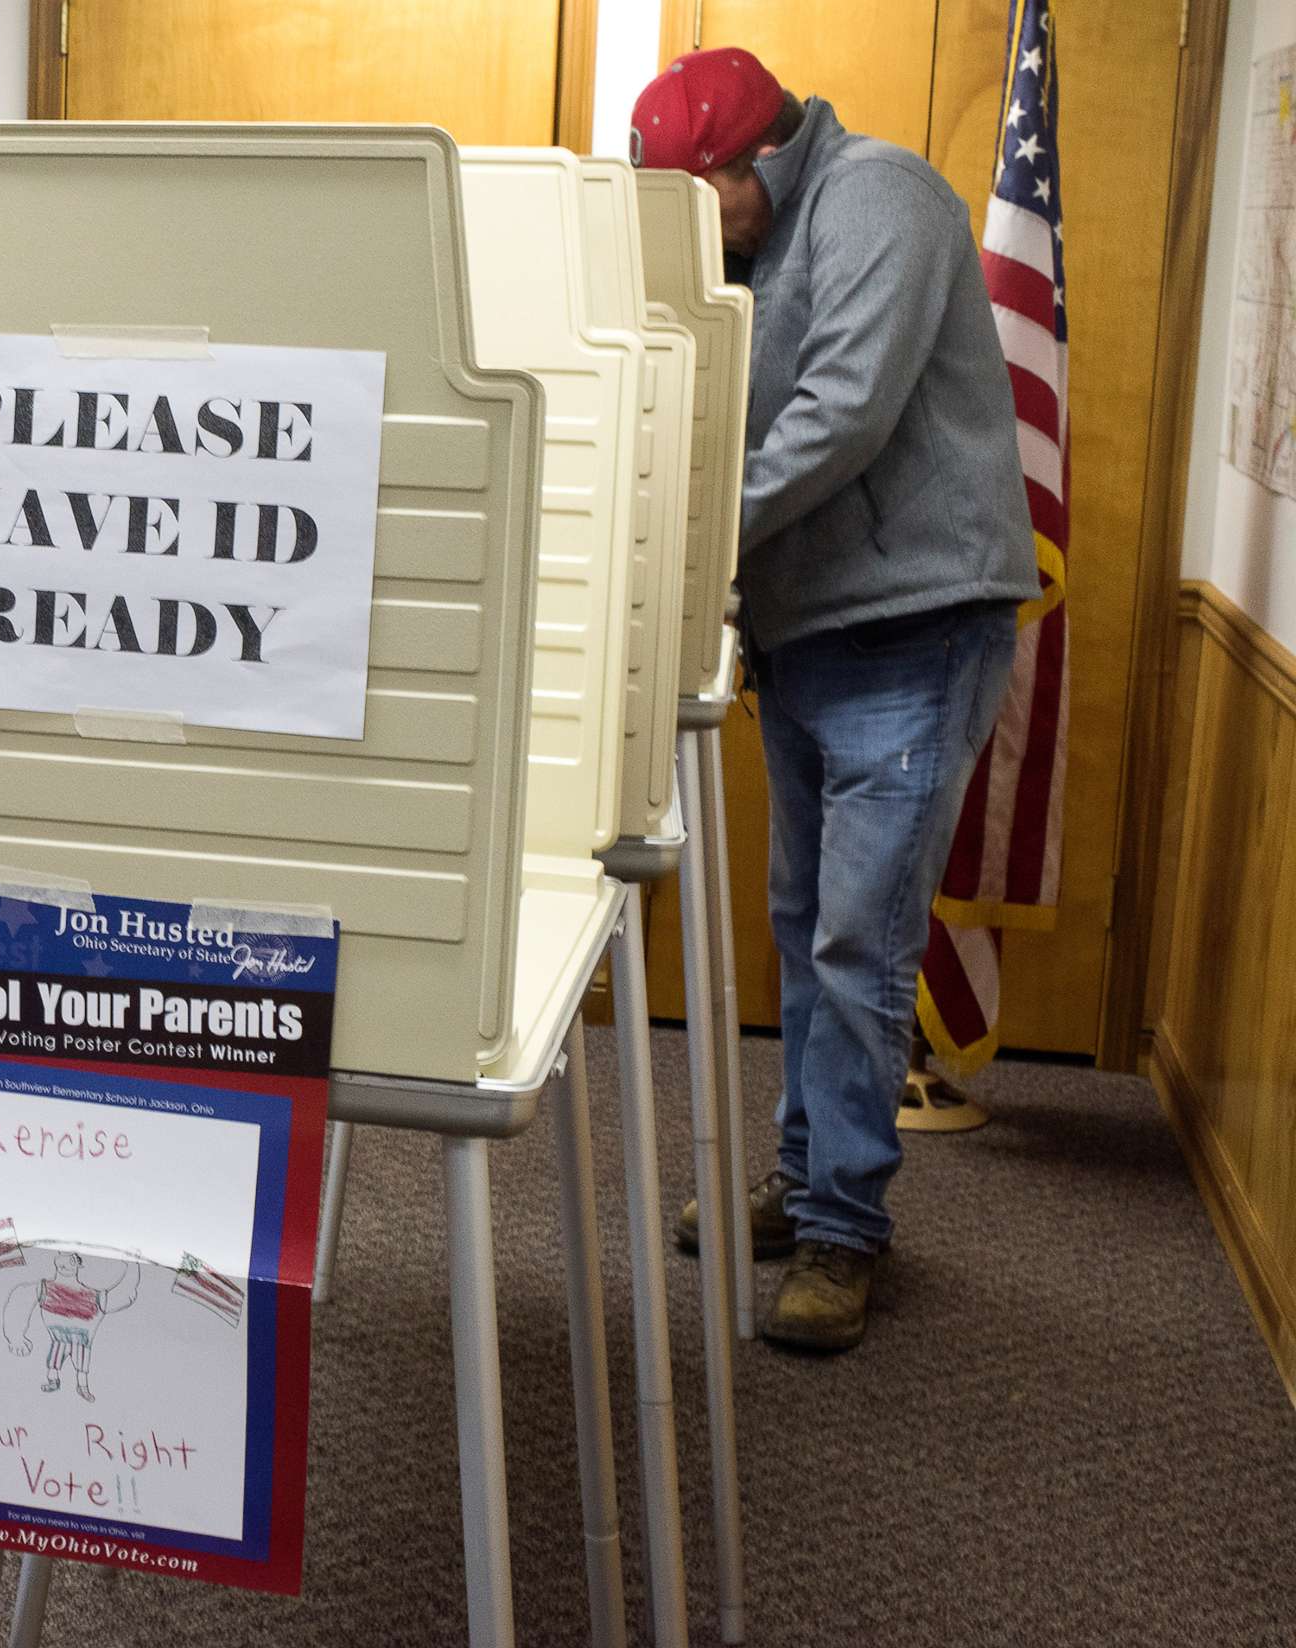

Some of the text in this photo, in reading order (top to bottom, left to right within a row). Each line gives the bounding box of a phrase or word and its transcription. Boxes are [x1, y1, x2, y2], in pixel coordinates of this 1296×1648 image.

[208, 501, 319, 565] ID
[55, 906, 235, 949] Jon Husted
[73, 934, 231, 965] Ohio Secretary of State
[37, 981, 131, 1028] Your
[139, 987, 303, 1041] Parents
[64, 1033, 122, 1053] Poster
[128, 1037, 204, 1059] Contest
[209, 1043, 277, 1065] Winner
[4, 1079, 51, 1094] Southview
[53, 1085, 104, 1103] Elementary
[104, 1092, 137, 1106] School
[138, 1095, 148, 1107] in
[191, 1102, 215, 1116] Ohio
[85, 1423, 198, 1471] Right
[21, 1456, 141, 1513] Vote!!
[8, 1510, 21, 1520] For
[22, 1512, 31, 1522] all
[32, 1515, 46, 1526] you
[48, 1517, 69, 1528] need
[70, 1521, 79, 1530] to
[80, 1523, 97, 1533] vote
[99, 1525, 107, 1534] in
